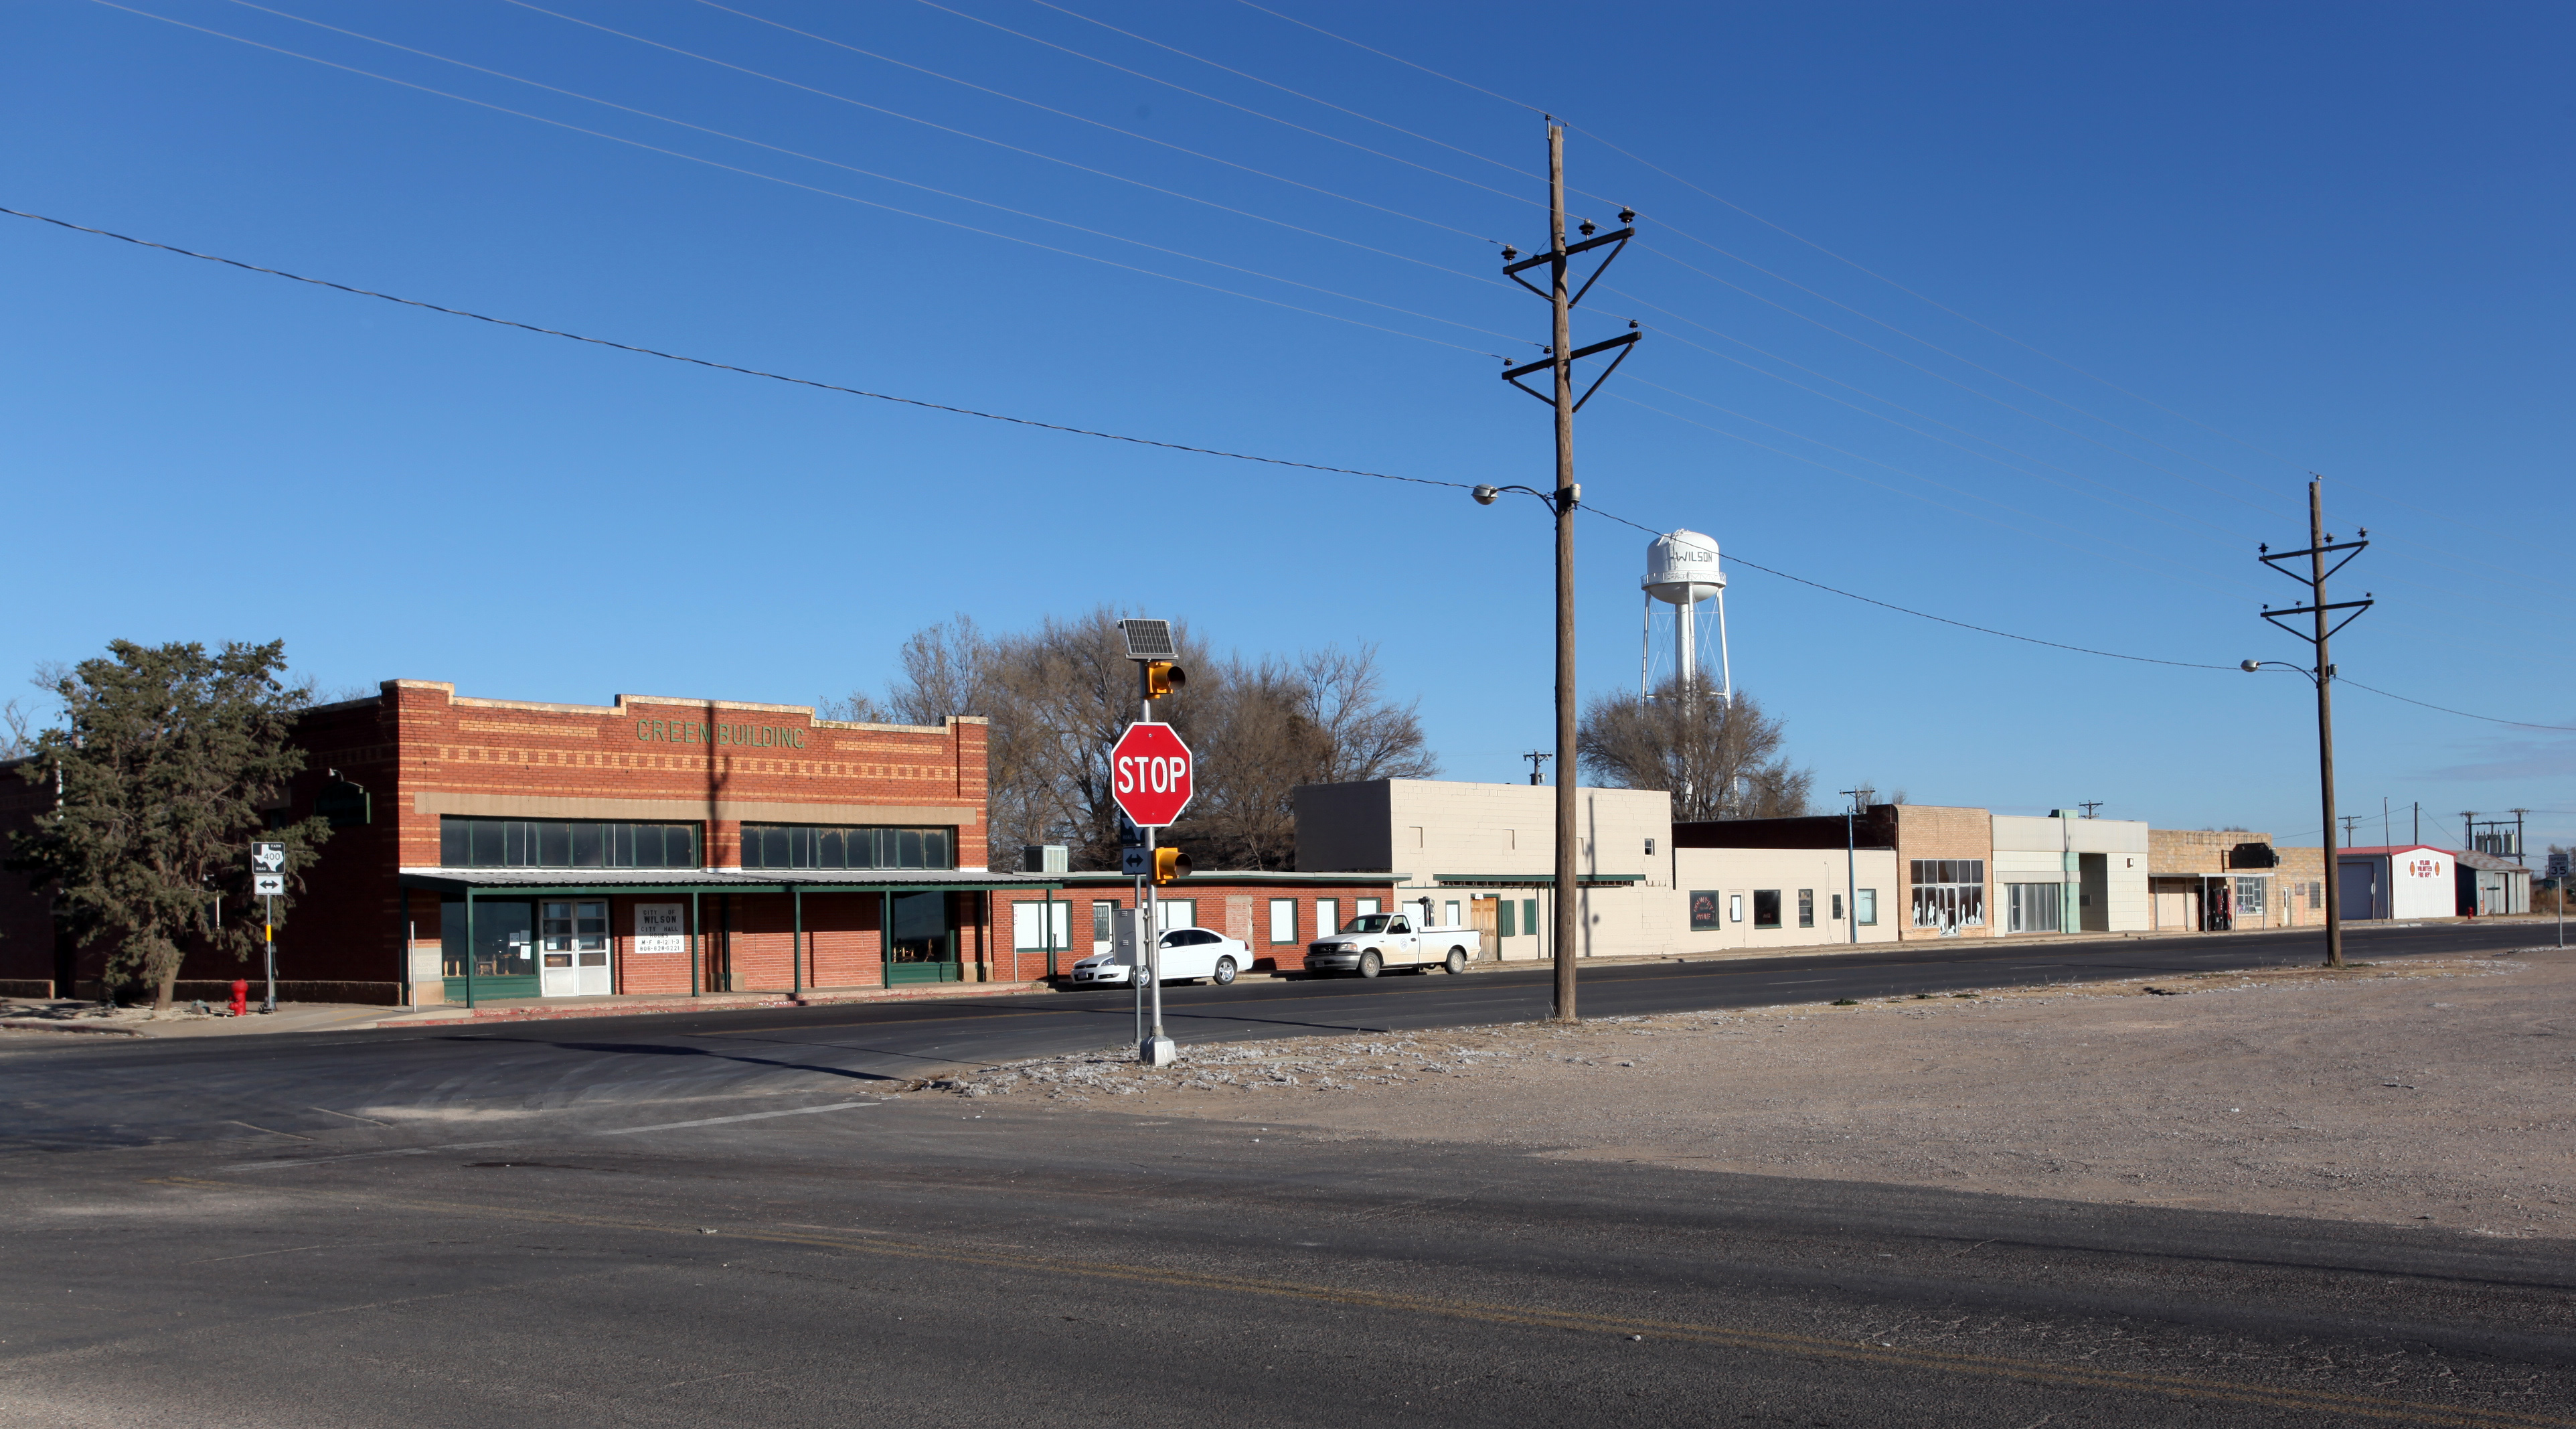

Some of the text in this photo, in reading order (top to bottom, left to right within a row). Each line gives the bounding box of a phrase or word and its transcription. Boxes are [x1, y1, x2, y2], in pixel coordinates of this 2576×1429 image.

[1676, 551, 1712, 562] WILSON
[637, 719, 805, 749] GREEN BUILDING
[1118, 755, 1187, 794] STOP
[2551, 866, 2567, 875] 35
[644, 915, 676, 923] WILSON
